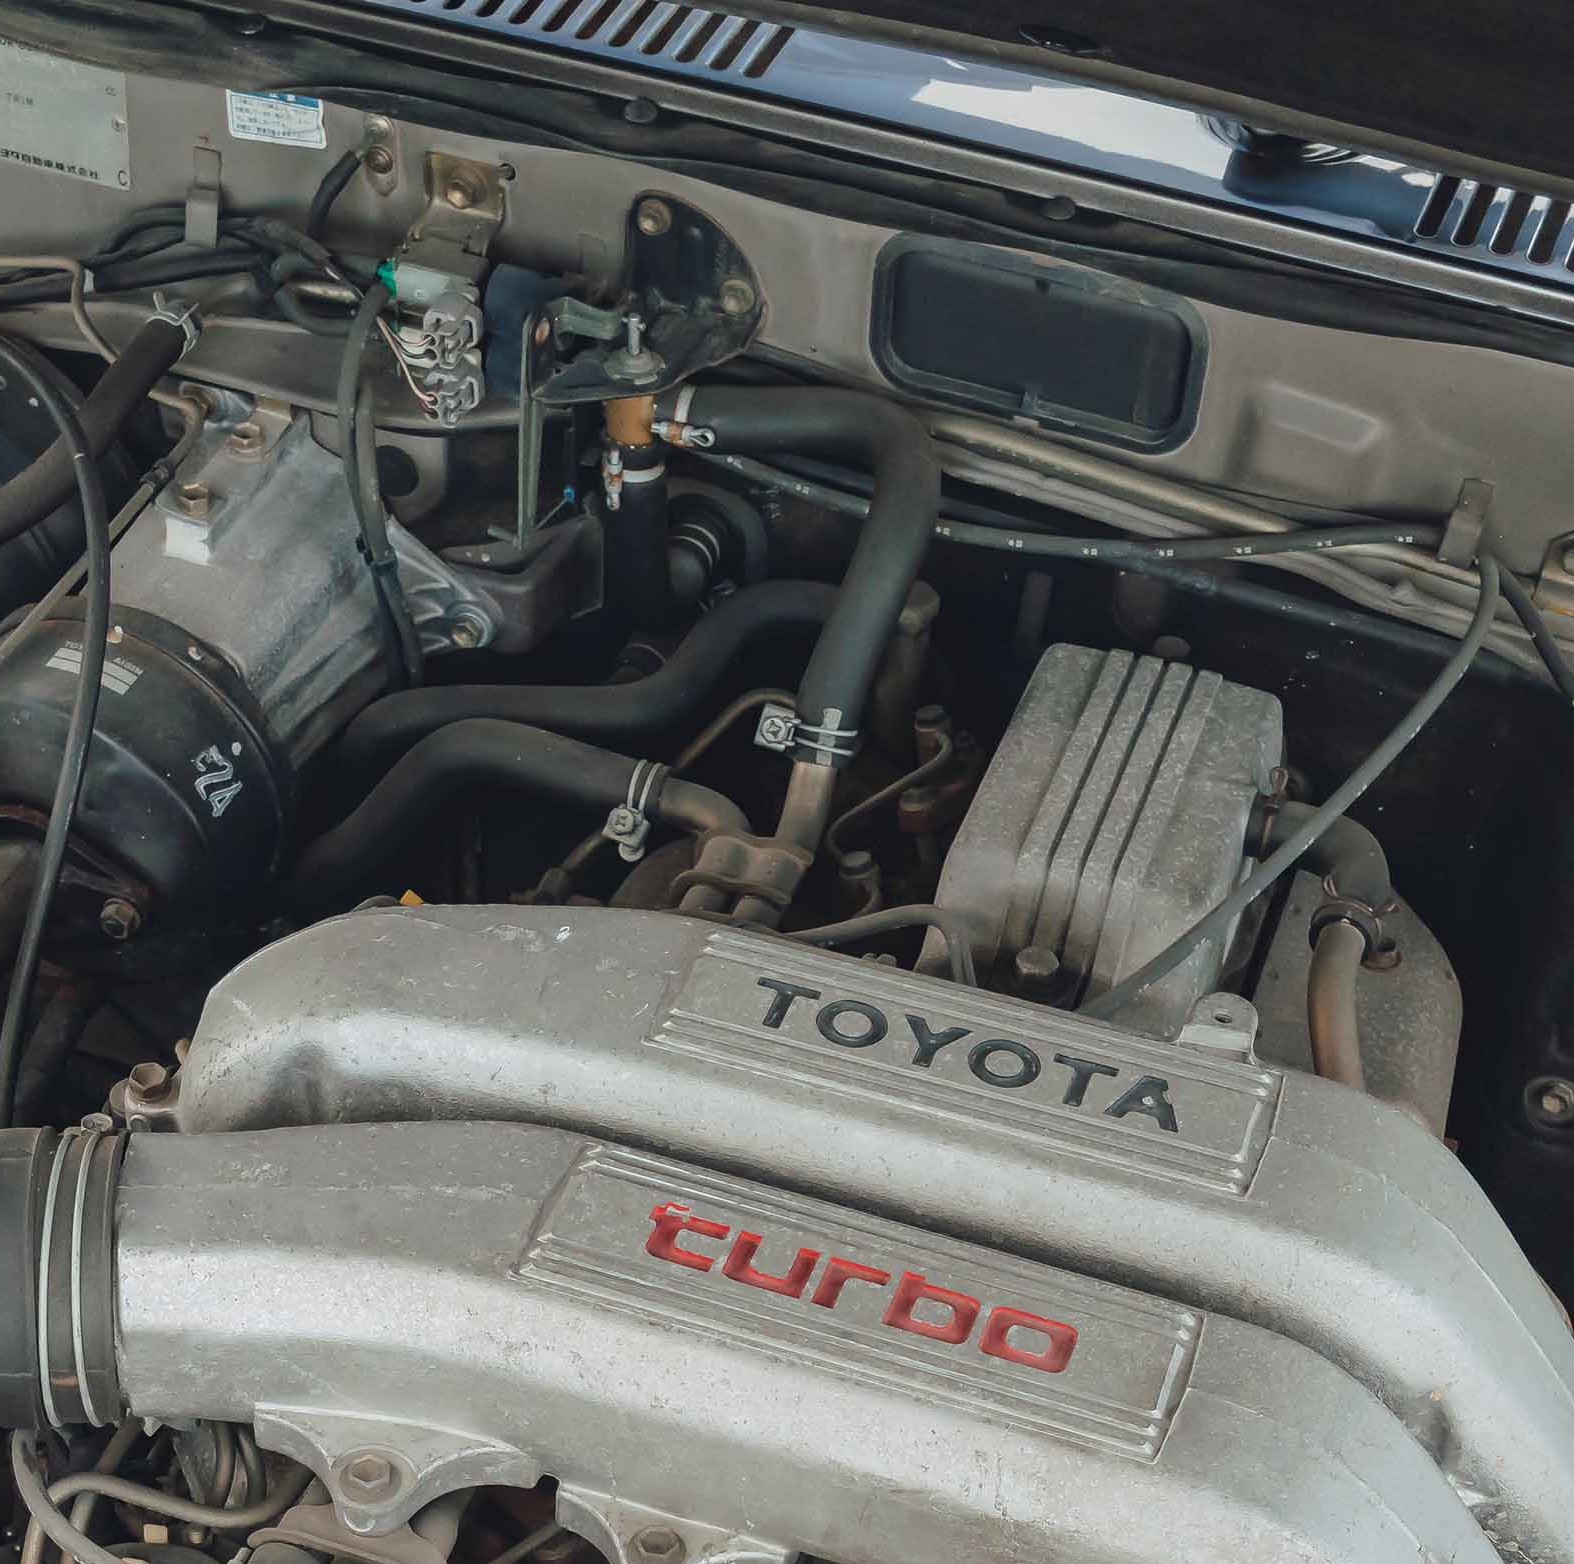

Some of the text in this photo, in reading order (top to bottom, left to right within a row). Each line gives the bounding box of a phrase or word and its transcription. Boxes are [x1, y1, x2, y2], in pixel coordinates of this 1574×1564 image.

[5, 92, 34, 106] TRIM
[117, 170, 129, 187] C
[756, 975, 1180, 1134] TOYOTA
[645, 1202, 1079, 1374] turbo
